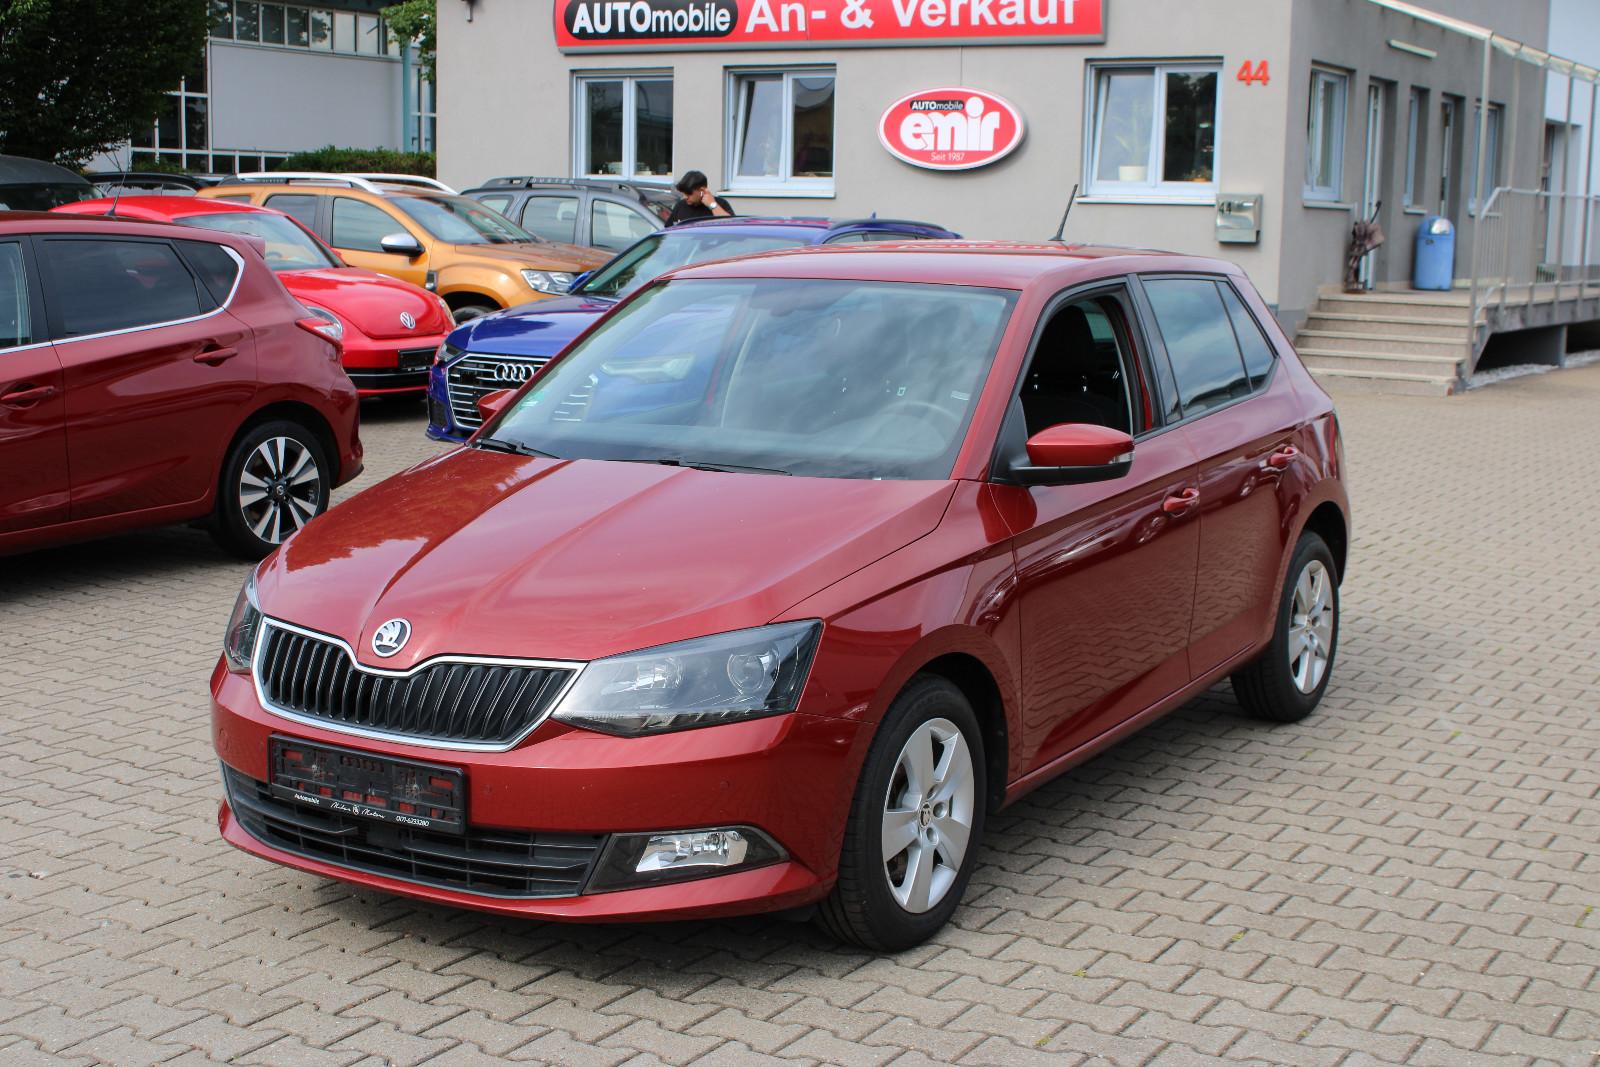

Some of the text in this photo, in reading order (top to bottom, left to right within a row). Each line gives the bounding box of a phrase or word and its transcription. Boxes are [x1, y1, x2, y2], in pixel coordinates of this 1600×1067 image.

[572, 0, 1079, 34] AUTOmobile An- & Verkauf
[1236, 59, 1270, 87] 44
[911, 101, 963, 110] AUTOmobile
[900, 96, 1000, 151] emir
[931, 152, 965, 160] Seit 1987
